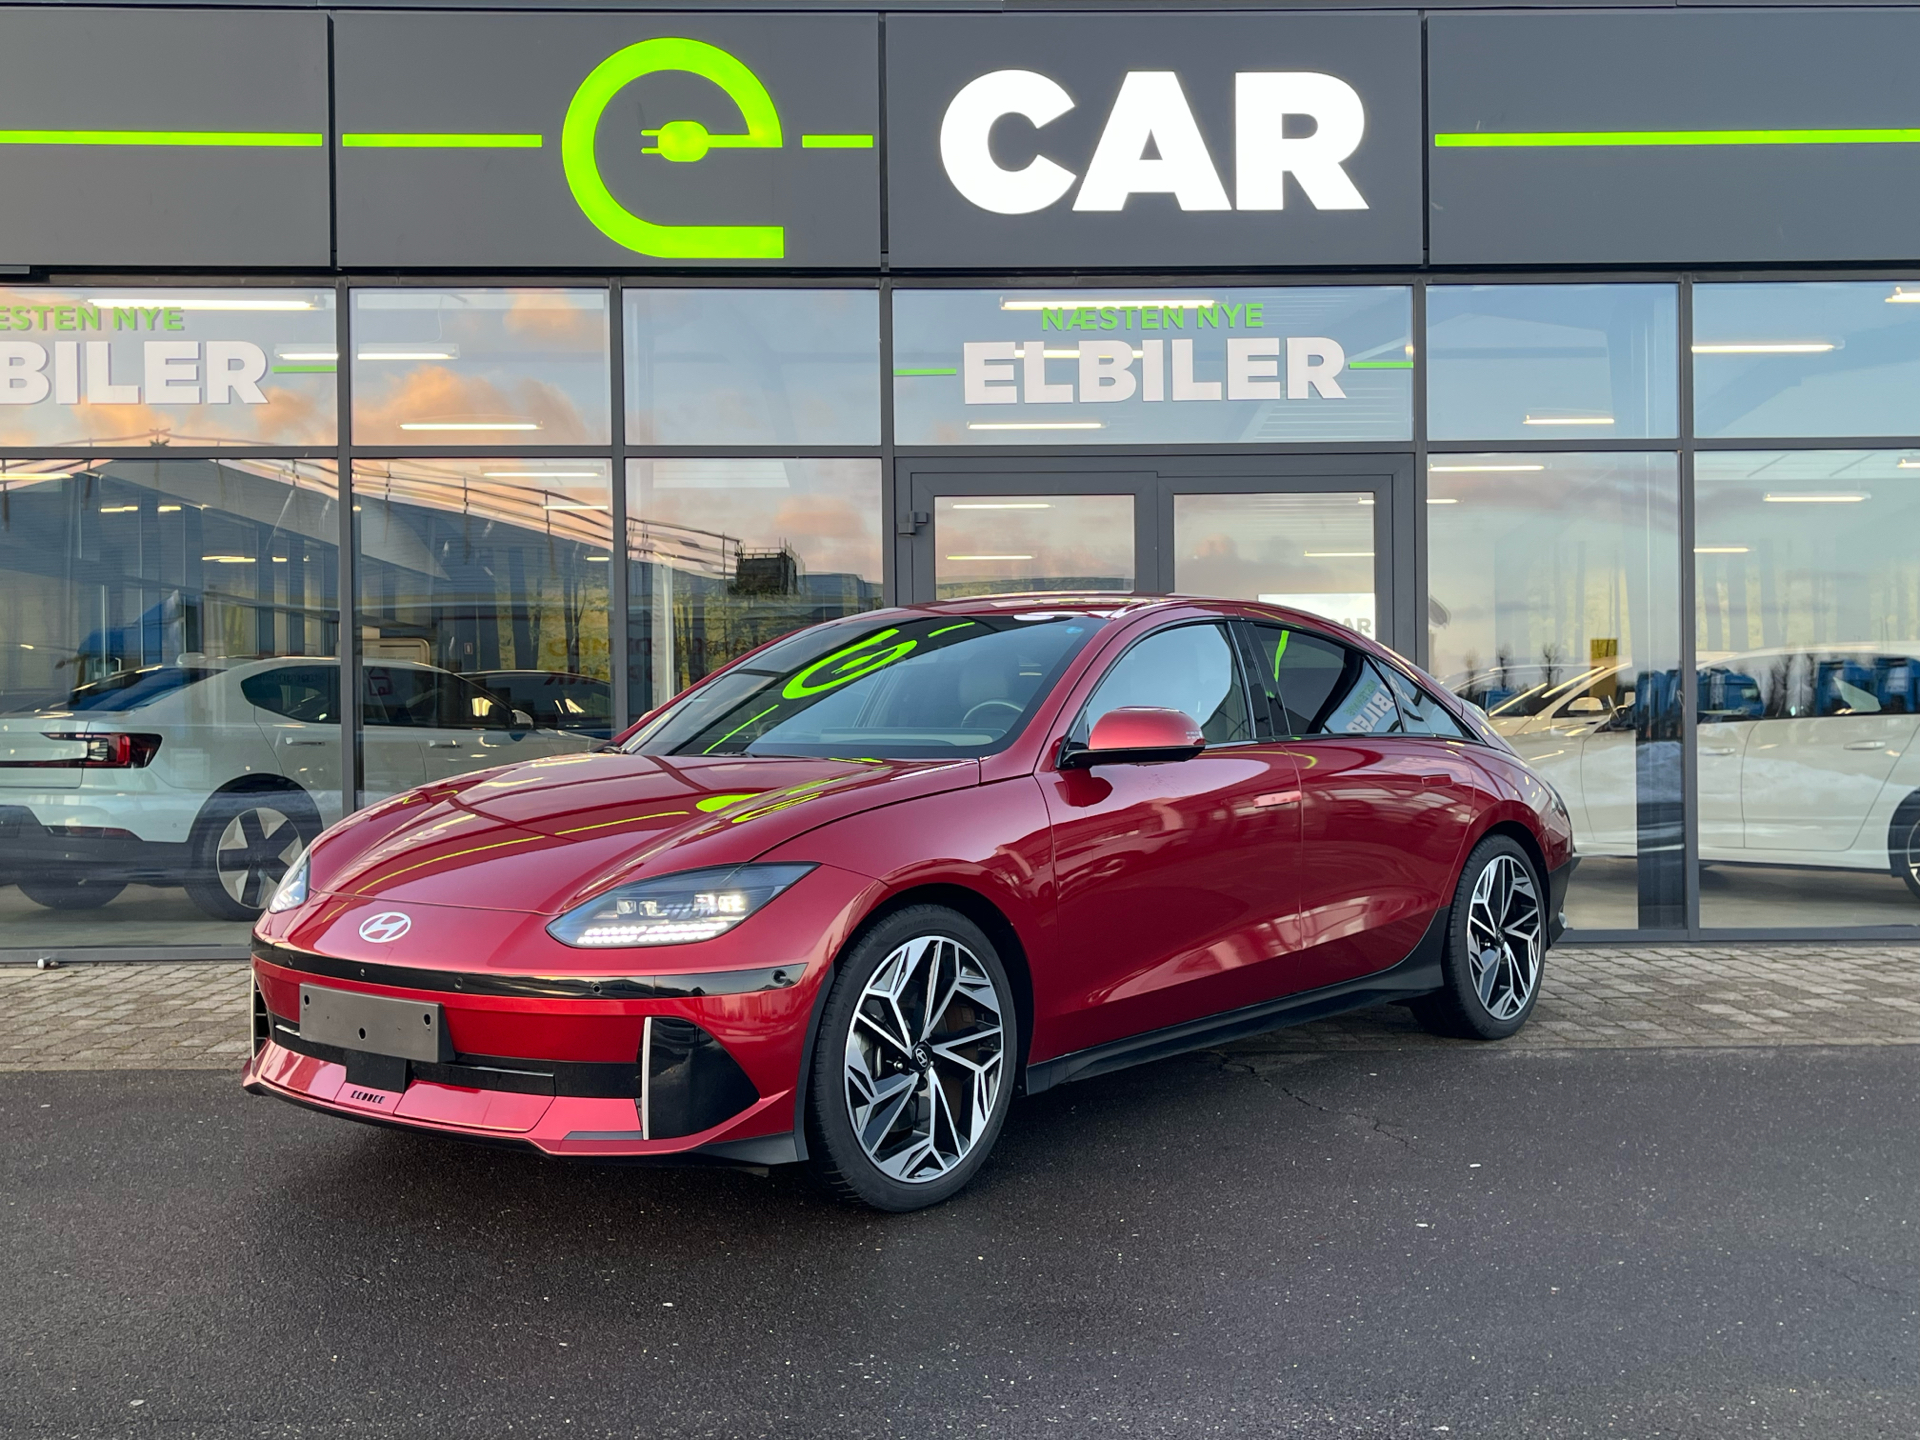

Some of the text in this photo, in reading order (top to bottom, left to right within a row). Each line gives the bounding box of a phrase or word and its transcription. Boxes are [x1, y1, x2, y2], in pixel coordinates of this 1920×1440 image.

[940, 69, 1370, 215] CAR
[112, 306, 185, 331] NYE
[1042, 303, 1265, 331] NÆSTEN NYE
[963, 337, 1347, 405] ELBILER
